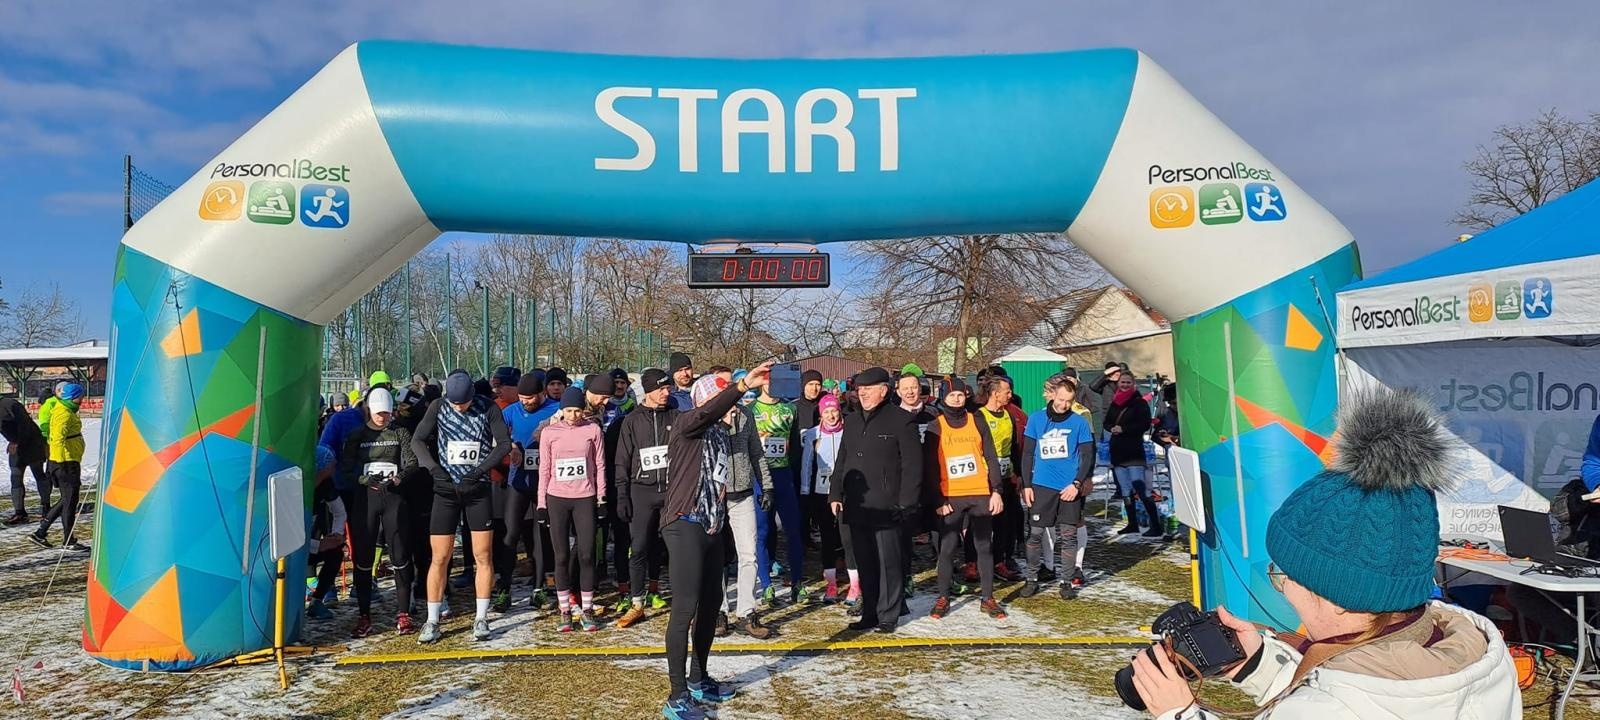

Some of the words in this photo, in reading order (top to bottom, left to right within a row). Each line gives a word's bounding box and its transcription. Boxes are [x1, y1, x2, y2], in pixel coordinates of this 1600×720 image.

[595, 86, 917, 173] START
[210, 158, 350, 183] PersonalBest
[1148, 161, 1276, 184] PersonalBest
[722, 259, 822, 281] 0:00:00
[1351, 295, 1461, 331] PersonalBest
[1042, 445, 1067, 455] 664
[558, 465, 585, 477] 728
[950, 461, 976, 475] 679
